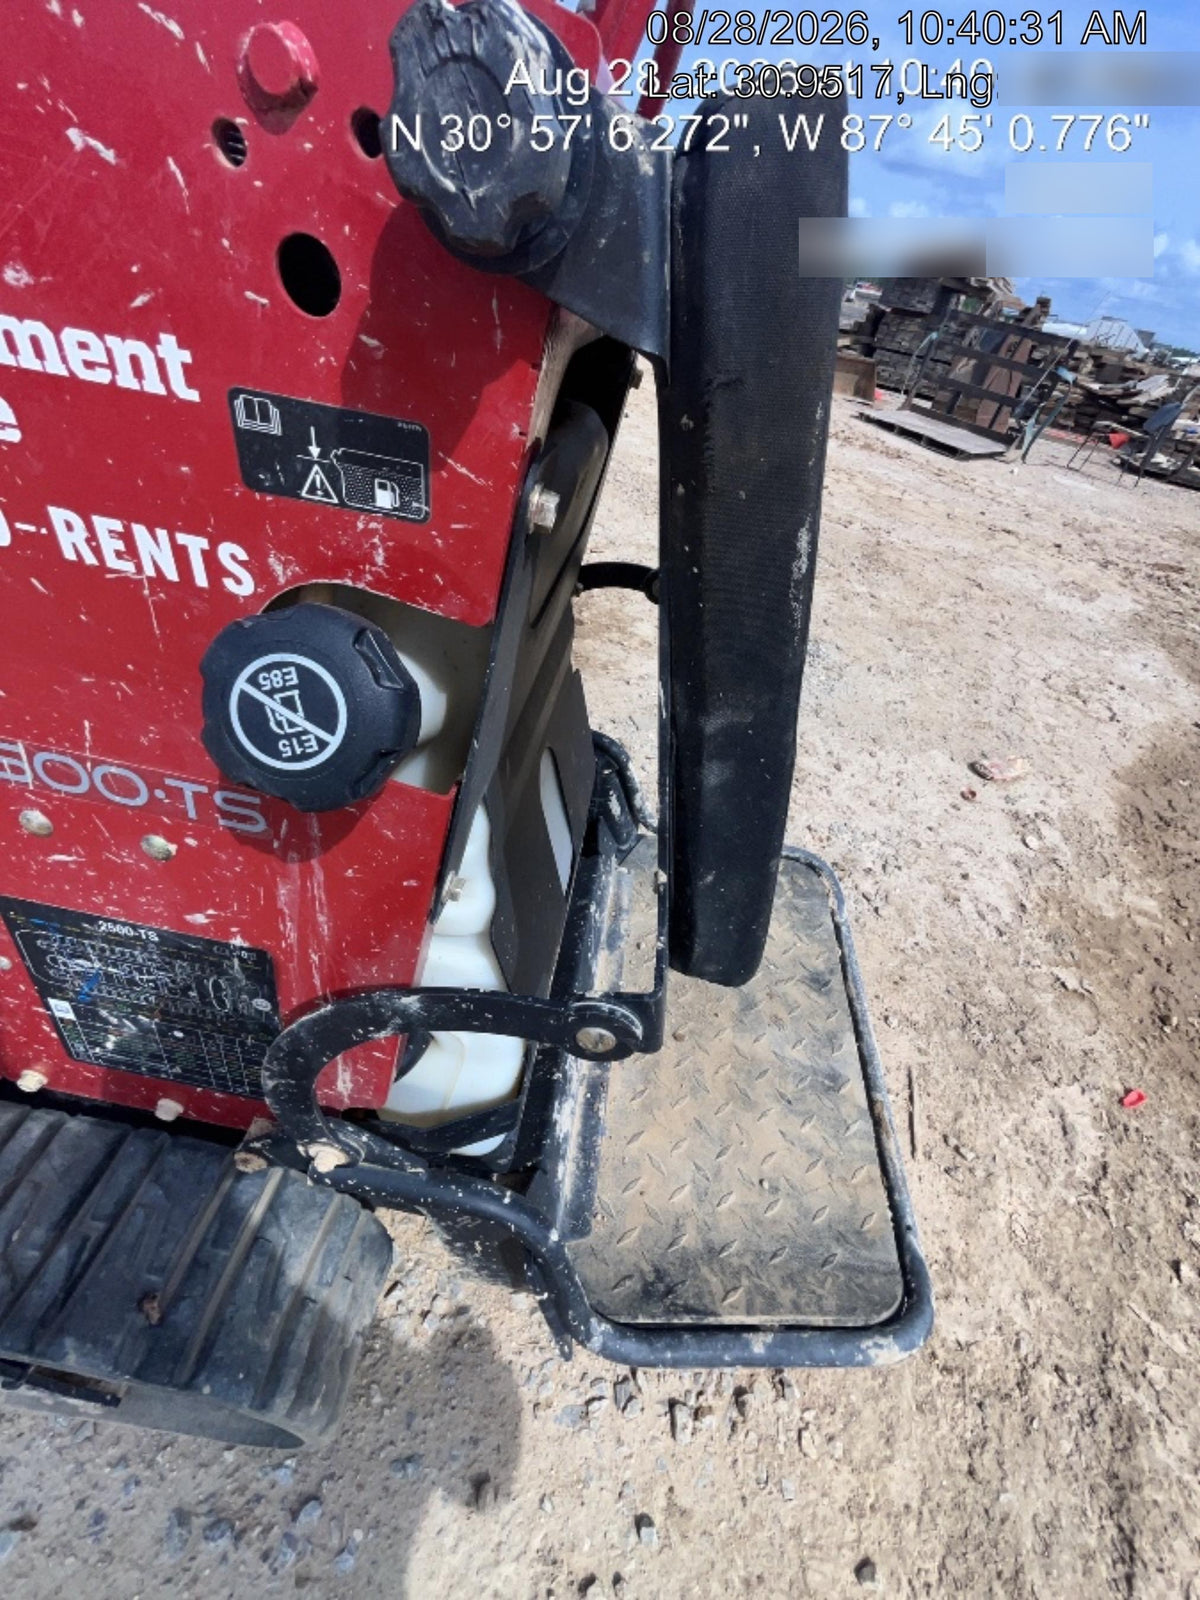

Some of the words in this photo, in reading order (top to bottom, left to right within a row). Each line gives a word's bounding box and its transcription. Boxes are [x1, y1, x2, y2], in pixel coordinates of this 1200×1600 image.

[0, 313, 201, 402] ment
[258, 666, 299, 691] E85
[278, 734, 319, 758] E15
